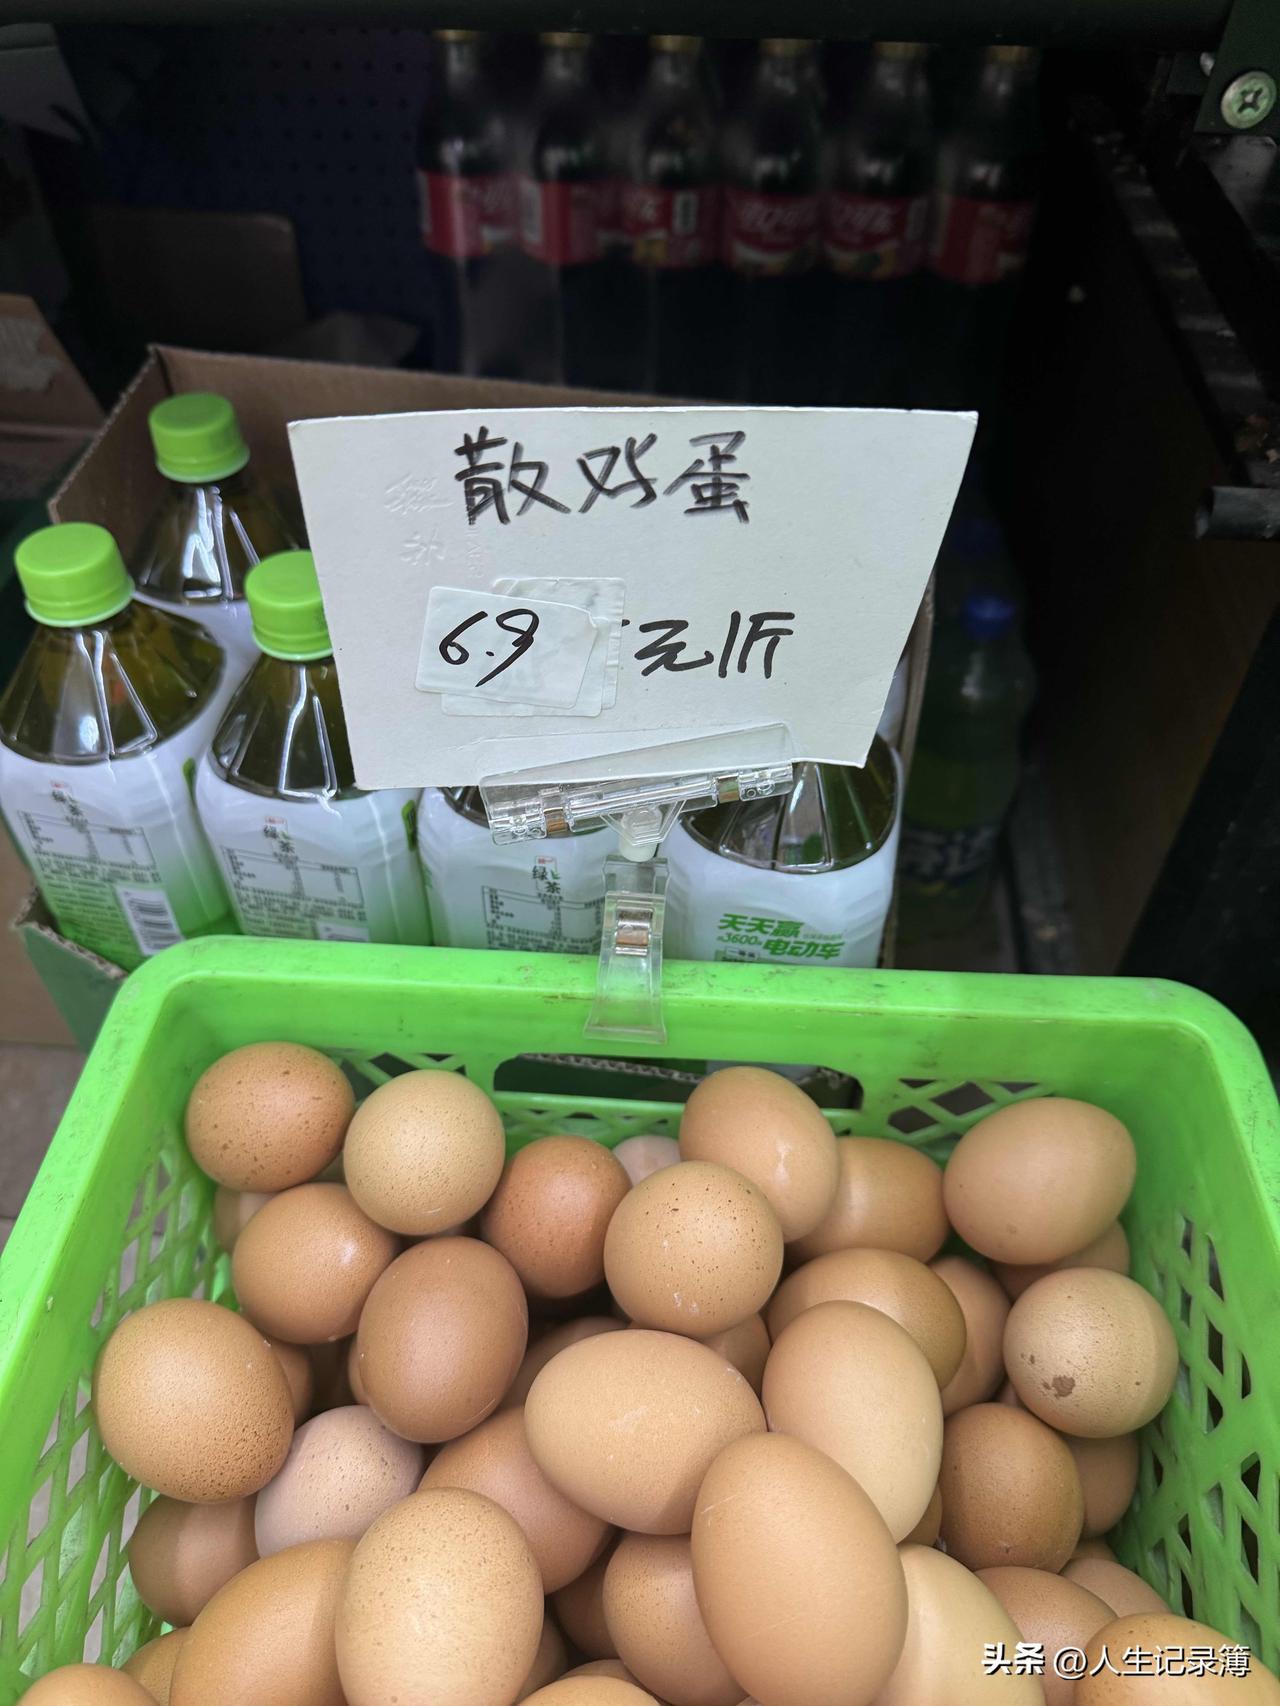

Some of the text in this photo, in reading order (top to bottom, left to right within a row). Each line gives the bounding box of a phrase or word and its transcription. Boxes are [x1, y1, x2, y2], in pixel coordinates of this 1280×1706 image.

[438, 607, 540, 688] 6.9
[717, 913, 805, 938] 天天赢
[762, 938, 846, 960] 电动车
